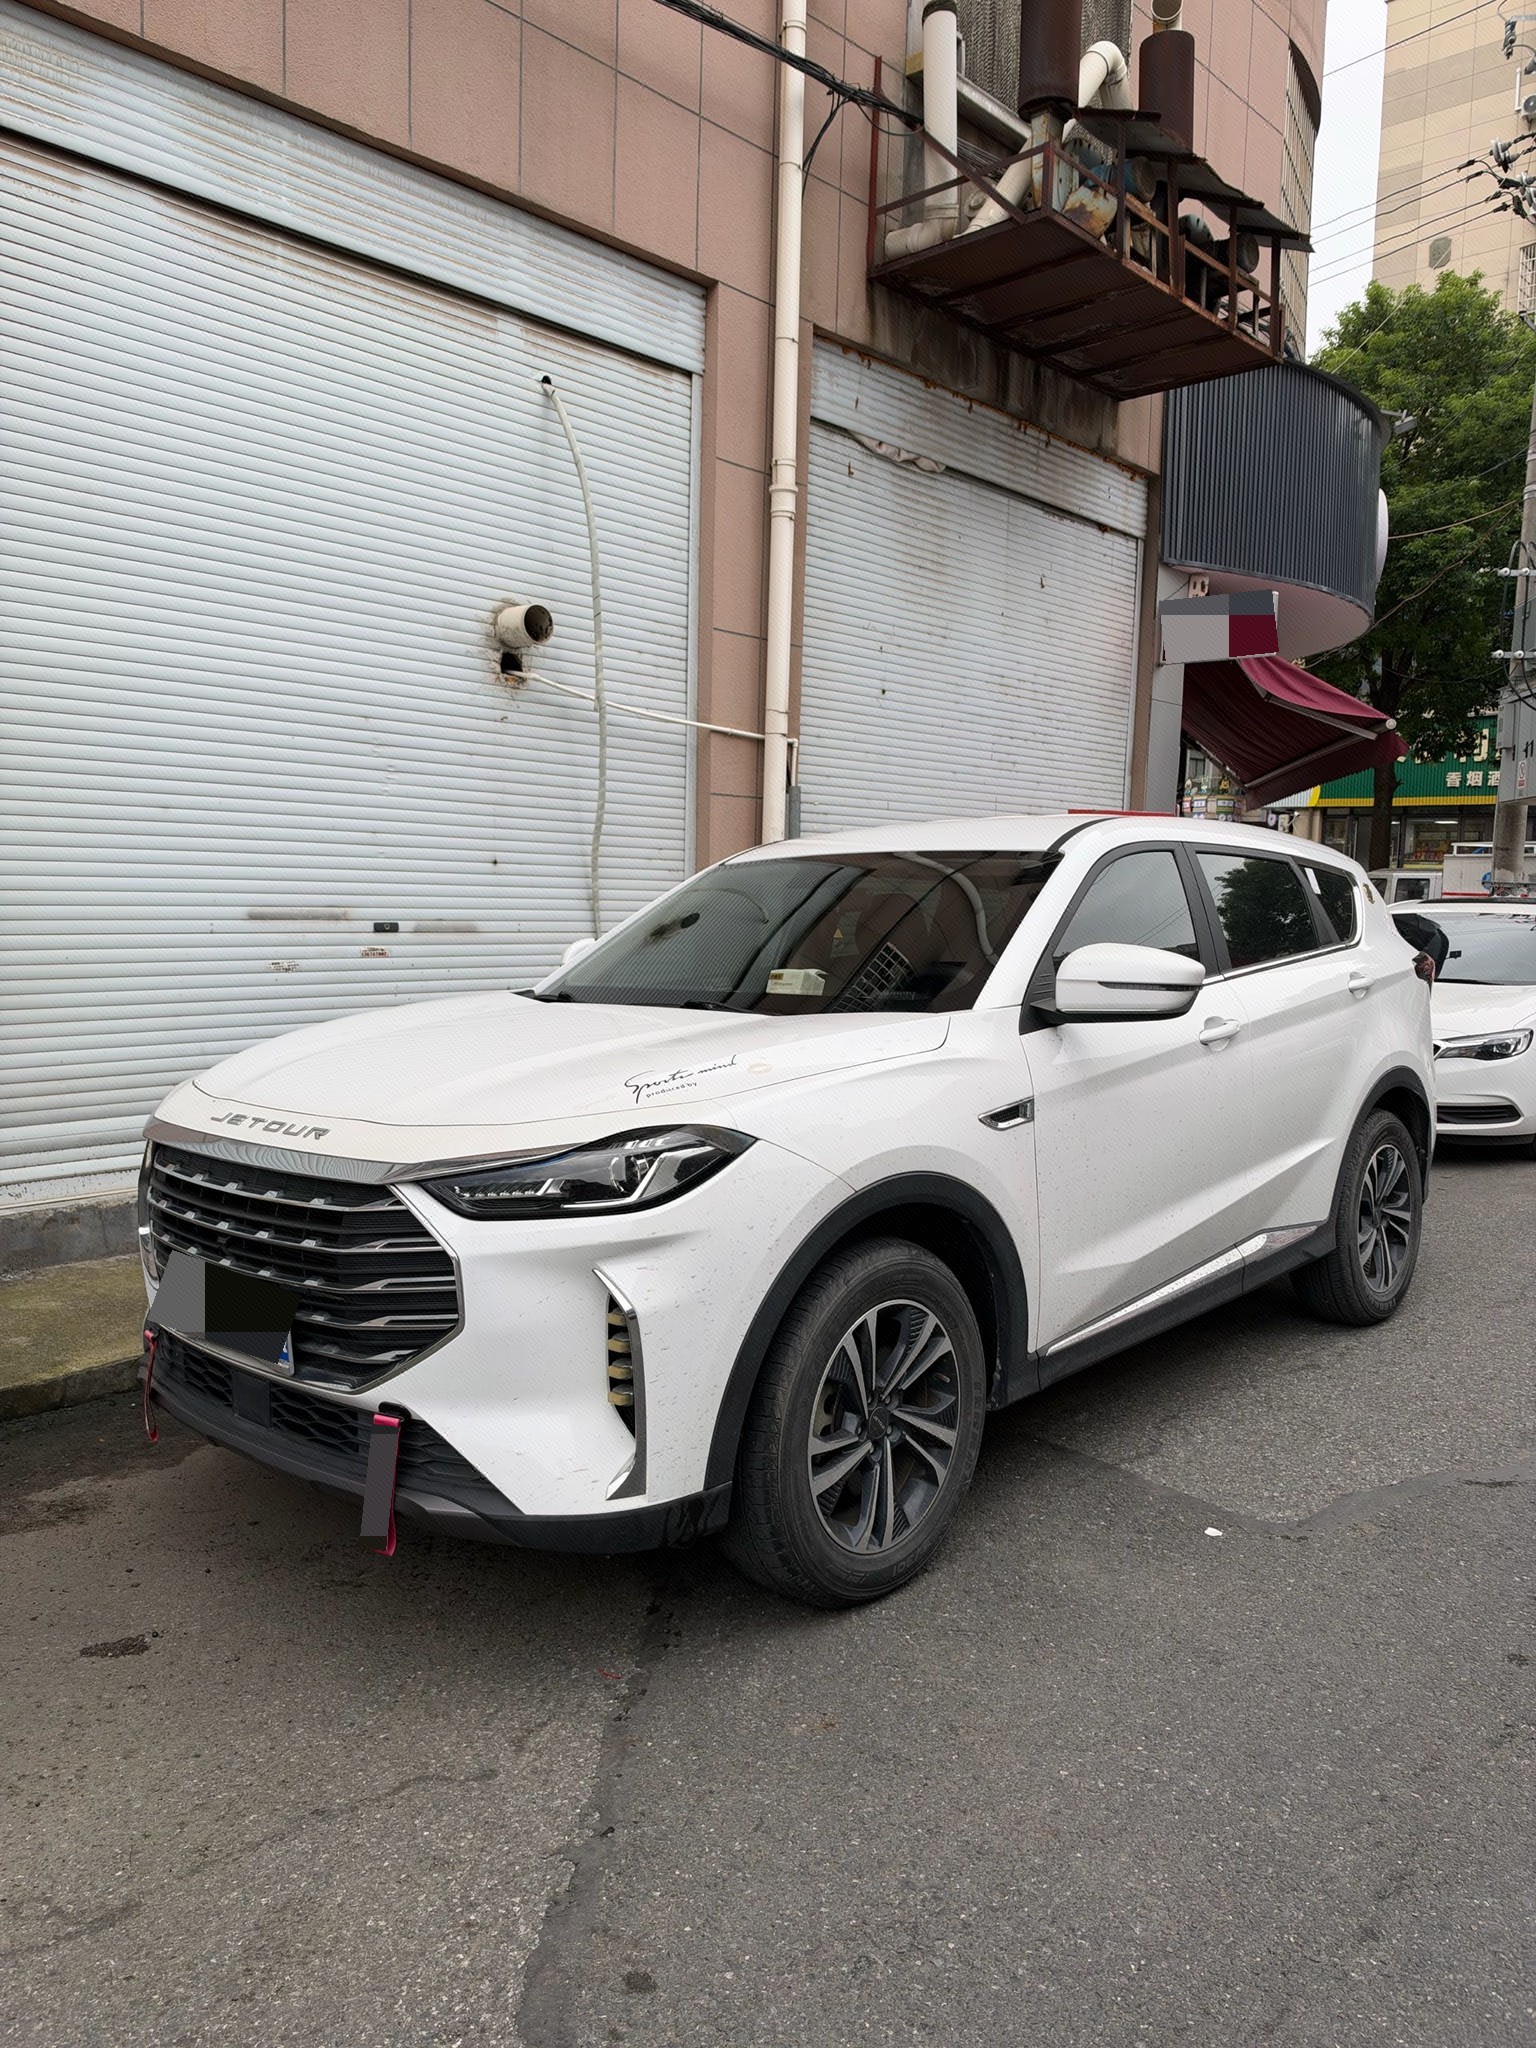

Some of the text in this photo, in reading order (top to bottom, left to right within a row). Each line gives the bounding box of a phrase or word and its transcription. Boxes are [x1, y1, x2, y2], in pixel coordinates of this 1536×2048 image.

[697, 1054, 737, 1074] mind
[645, 1083, 686, 1098] produced
[210, 1112, 330, 1140] JETOUR
